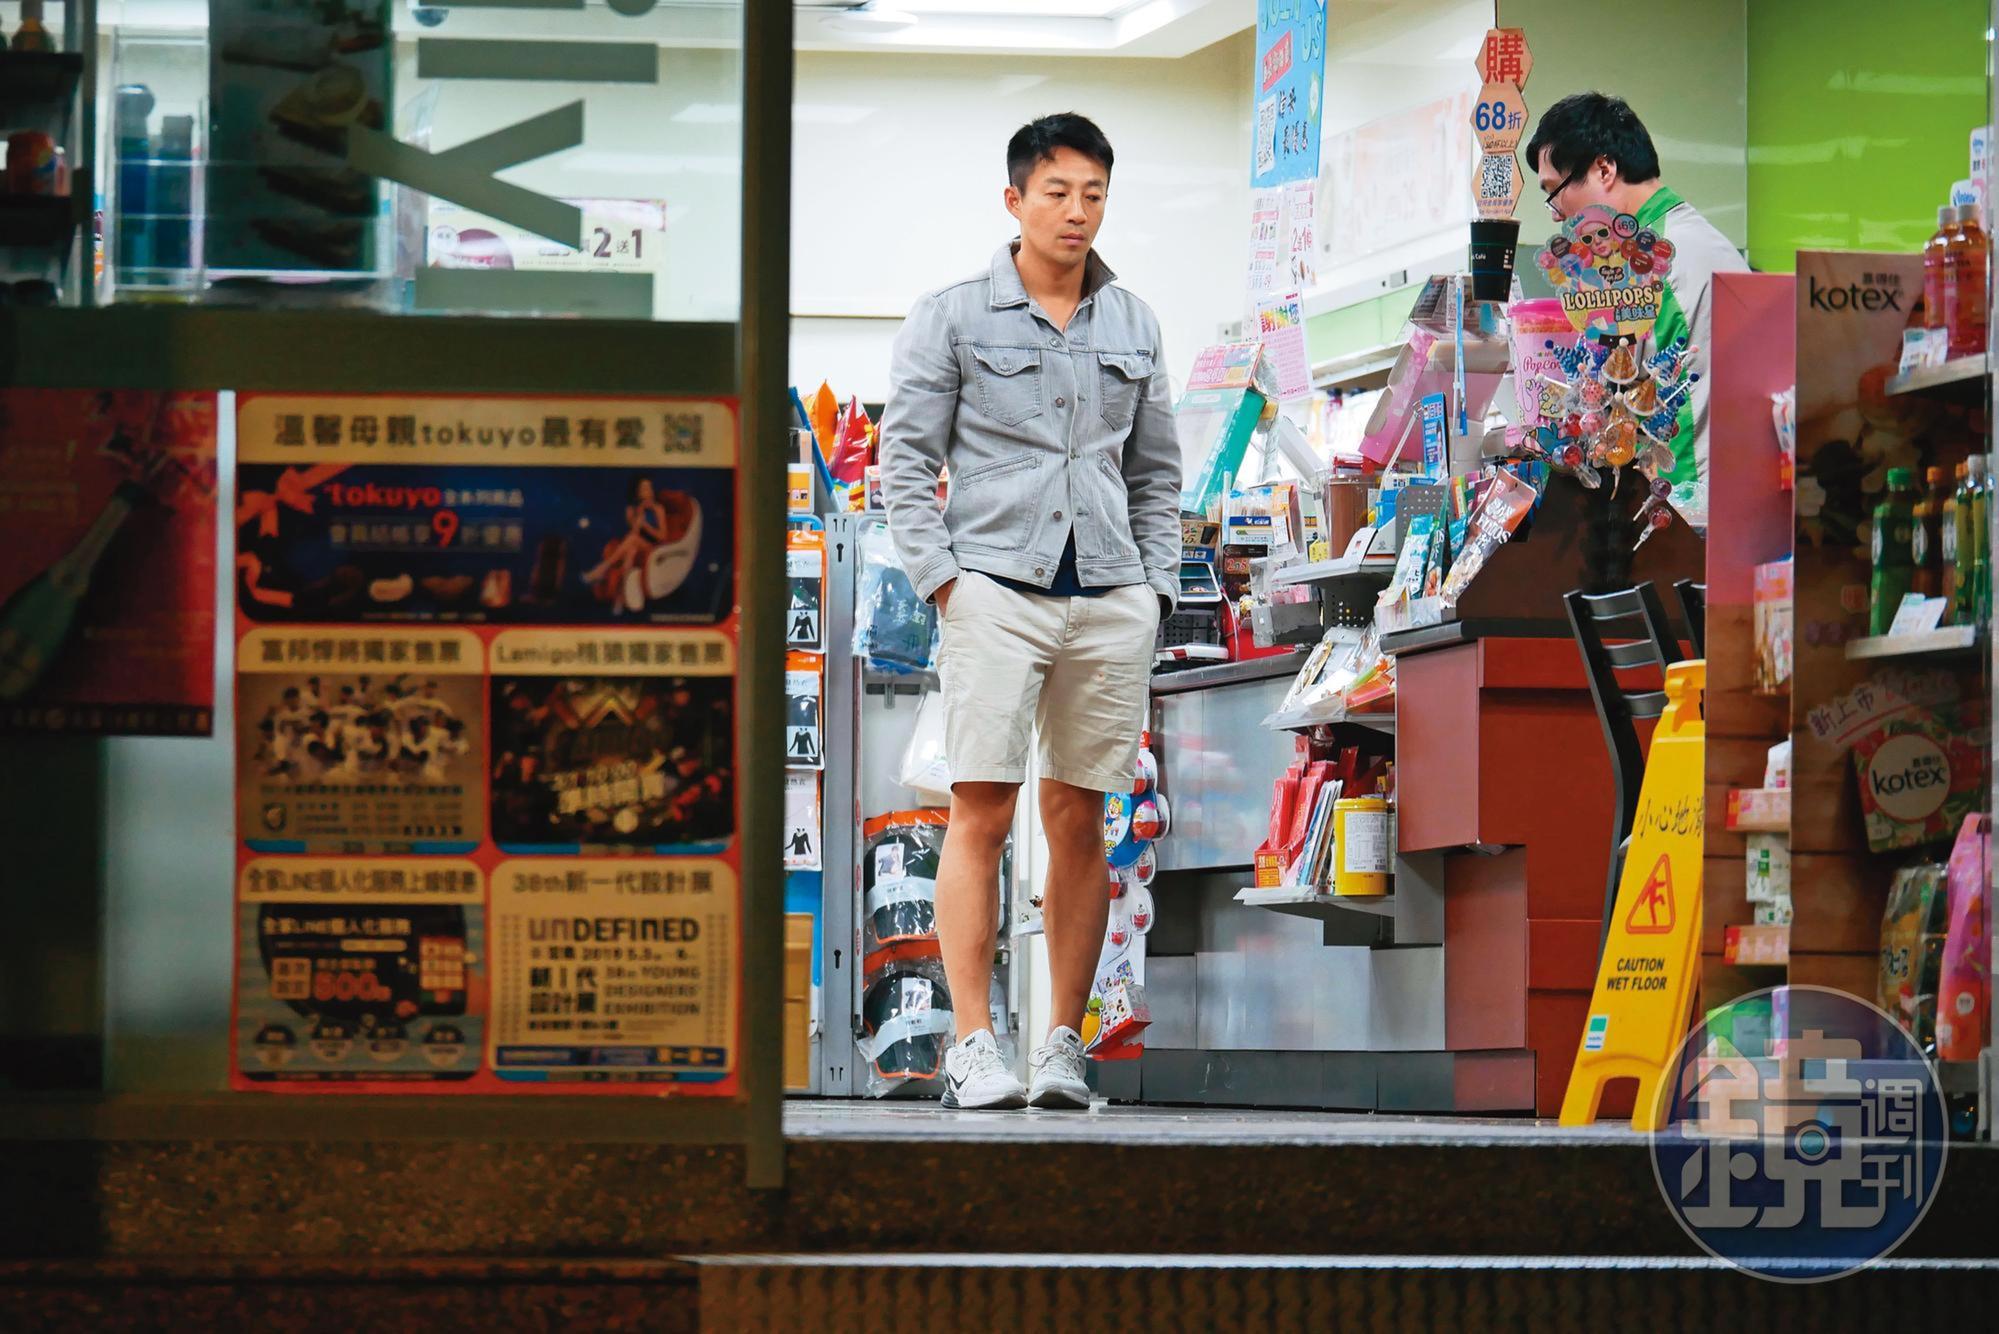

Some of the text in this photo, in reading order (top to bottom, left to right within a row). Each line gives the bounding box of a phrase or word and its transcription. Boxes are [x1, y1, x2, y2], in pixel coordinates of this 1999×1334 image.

[1485, 34, 1523, 84] 購
[1475, 101, 1522, 131] 68折
[1564, 286, 1655, 310] LOLLIPOPS
[1809, 276, 1900, 311] kotex
[325, 483, 441, 510] tokuyo
[1872, 766, 1947, 796] kotex
[1616, 957, 1665, 972] CAUTION
[1606, 976, 1668, 991] WET FLOOR
